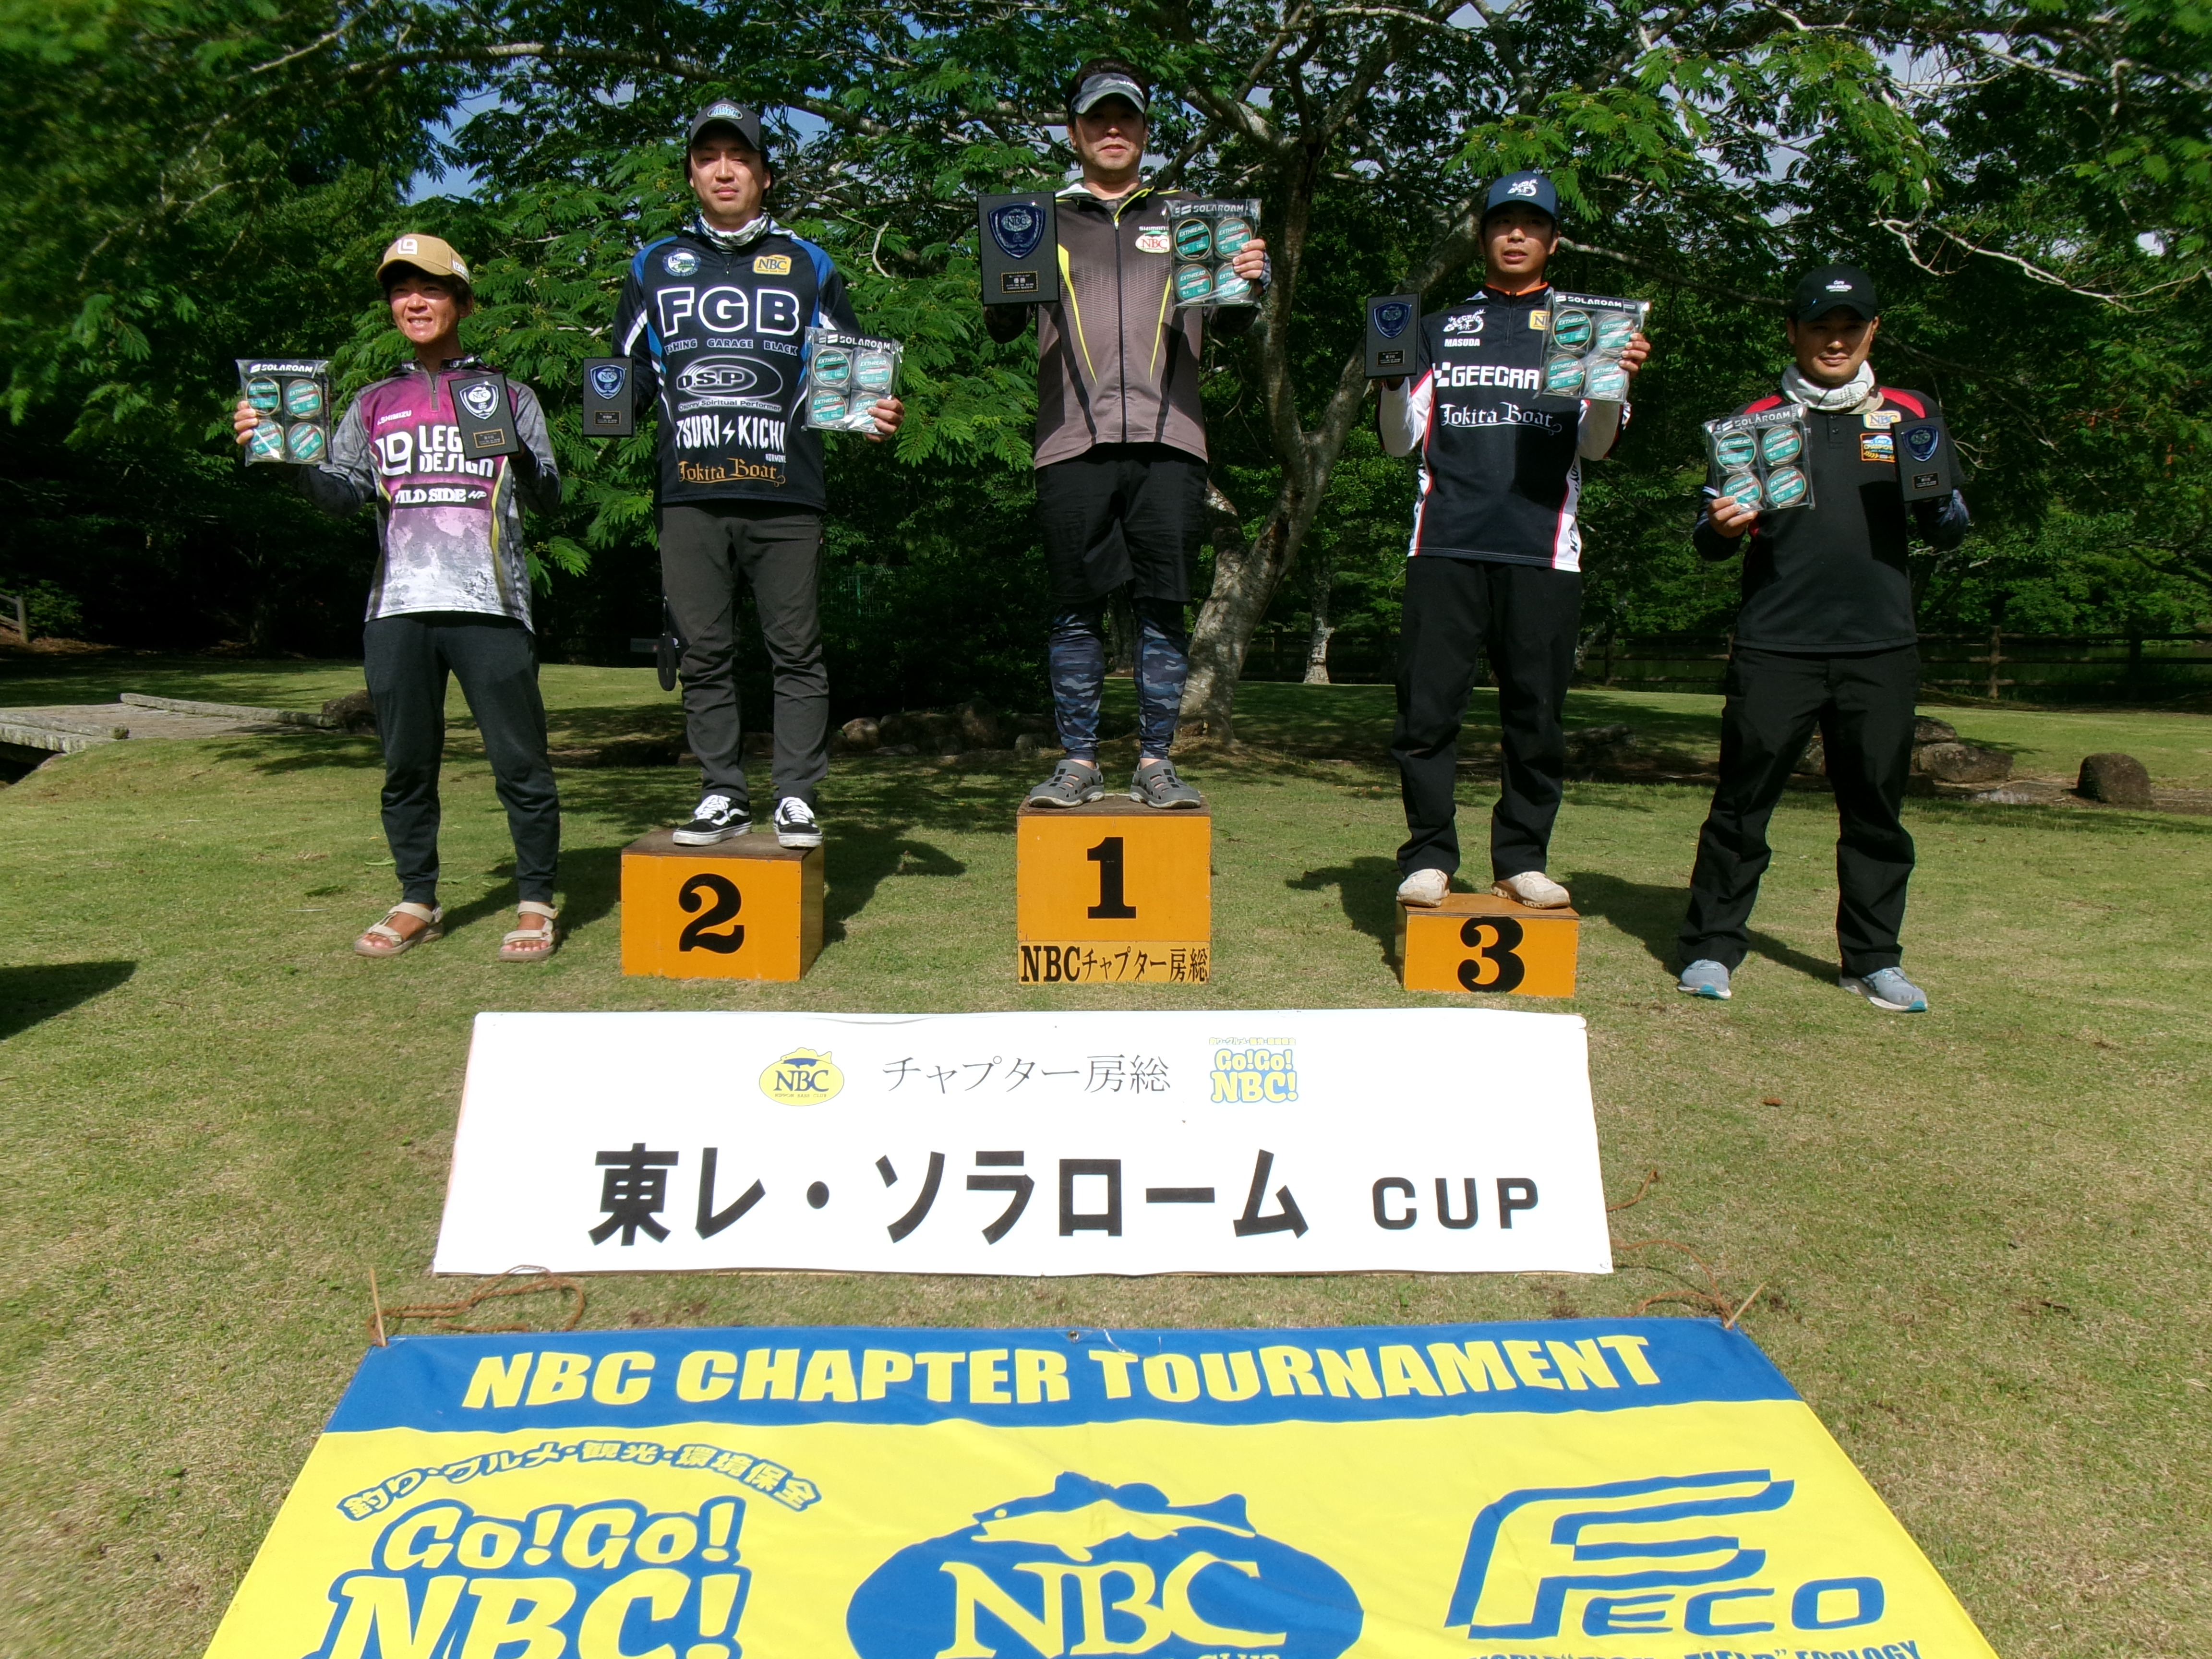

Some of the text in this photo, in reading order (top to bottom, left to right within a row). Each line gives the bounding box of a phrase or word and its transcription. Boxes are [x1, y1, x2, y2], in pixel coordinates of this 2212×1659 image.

[1193, 204, 1244, 213] SOLAROAM
[1178, 225, 1204, 237] EXTHREAD
[1219, 224, 1245, 236] EXTHREAD
[1141, 238, 1167, 249] NBC
[757, 258, 787, 270] NBC
[1180, 270, 1206, 281] EXTHREAD
[1567, 296, 1622, 308] SOLAROAM
[657, 286, 800, 337] FGB
[1558, 316, 1587, 326] EXTHREAD
[1601, 321, 1630, 330] EXTHREAD
[707, 338, 754, 349] GARAGE
[763, 340, 798, 356] BLACK
[840, 336, 890, 350] SOLAROAM
[1444, 338, 1480, 347] MASUDA
[818, 356, 844, 364] EXTHREAD
[1550, 361, 1578, 371] EXTHREAD
[261, 364, 313, 373] SOLAROAM
[677, 370, 744, 390] O.S.P
[289, 385, 314, 397] EXTHREAD
[679, 401, 700, 410] Osprey
[740, 400, 781, 411] Performer
[814, 397, 841, 405] EXTHREAD
[1734, 410, 1791, 427] SOLAROAM
[291, 425, 312, 445] EXTHREAD
[676, 414, 785, 454] TSURI KICHI
[1765, 430, 1793, 445] EXTHREAD
[1721, 439, 1751, 447] EXTHREAD
[419, 453, 494, 478] DESIGN
[1726, 477, 1753, 493] EXTHREAD
[1770, 471, 1797, 487] EXTHREAD
[428, 488, 466, 503] SIDE
[1087, 837, 1137, 919] 1
[679, 873, 745, 954] 2
[1457, 916, 1525, 993] 3
[1021, 946, 1208, 982] NBCチャプター房総
[1215, 1048, 1293, 1070] Go!Go!
[773, 1070, 830, 1092] NBC
[882, 1054, 1171, 1094] チャプター房総
[1210, 1070, 1298, 1103] NBC!
[589, 1142, 1539, 1246] 東レ・ソラローム CUP
[462, 1335, 1661, 1408] NBC CHAPTER TOURNAMENT
[374, 1497, 745, 1572] Go!Go!
[934, 1551, 1287, 1659] NBC
